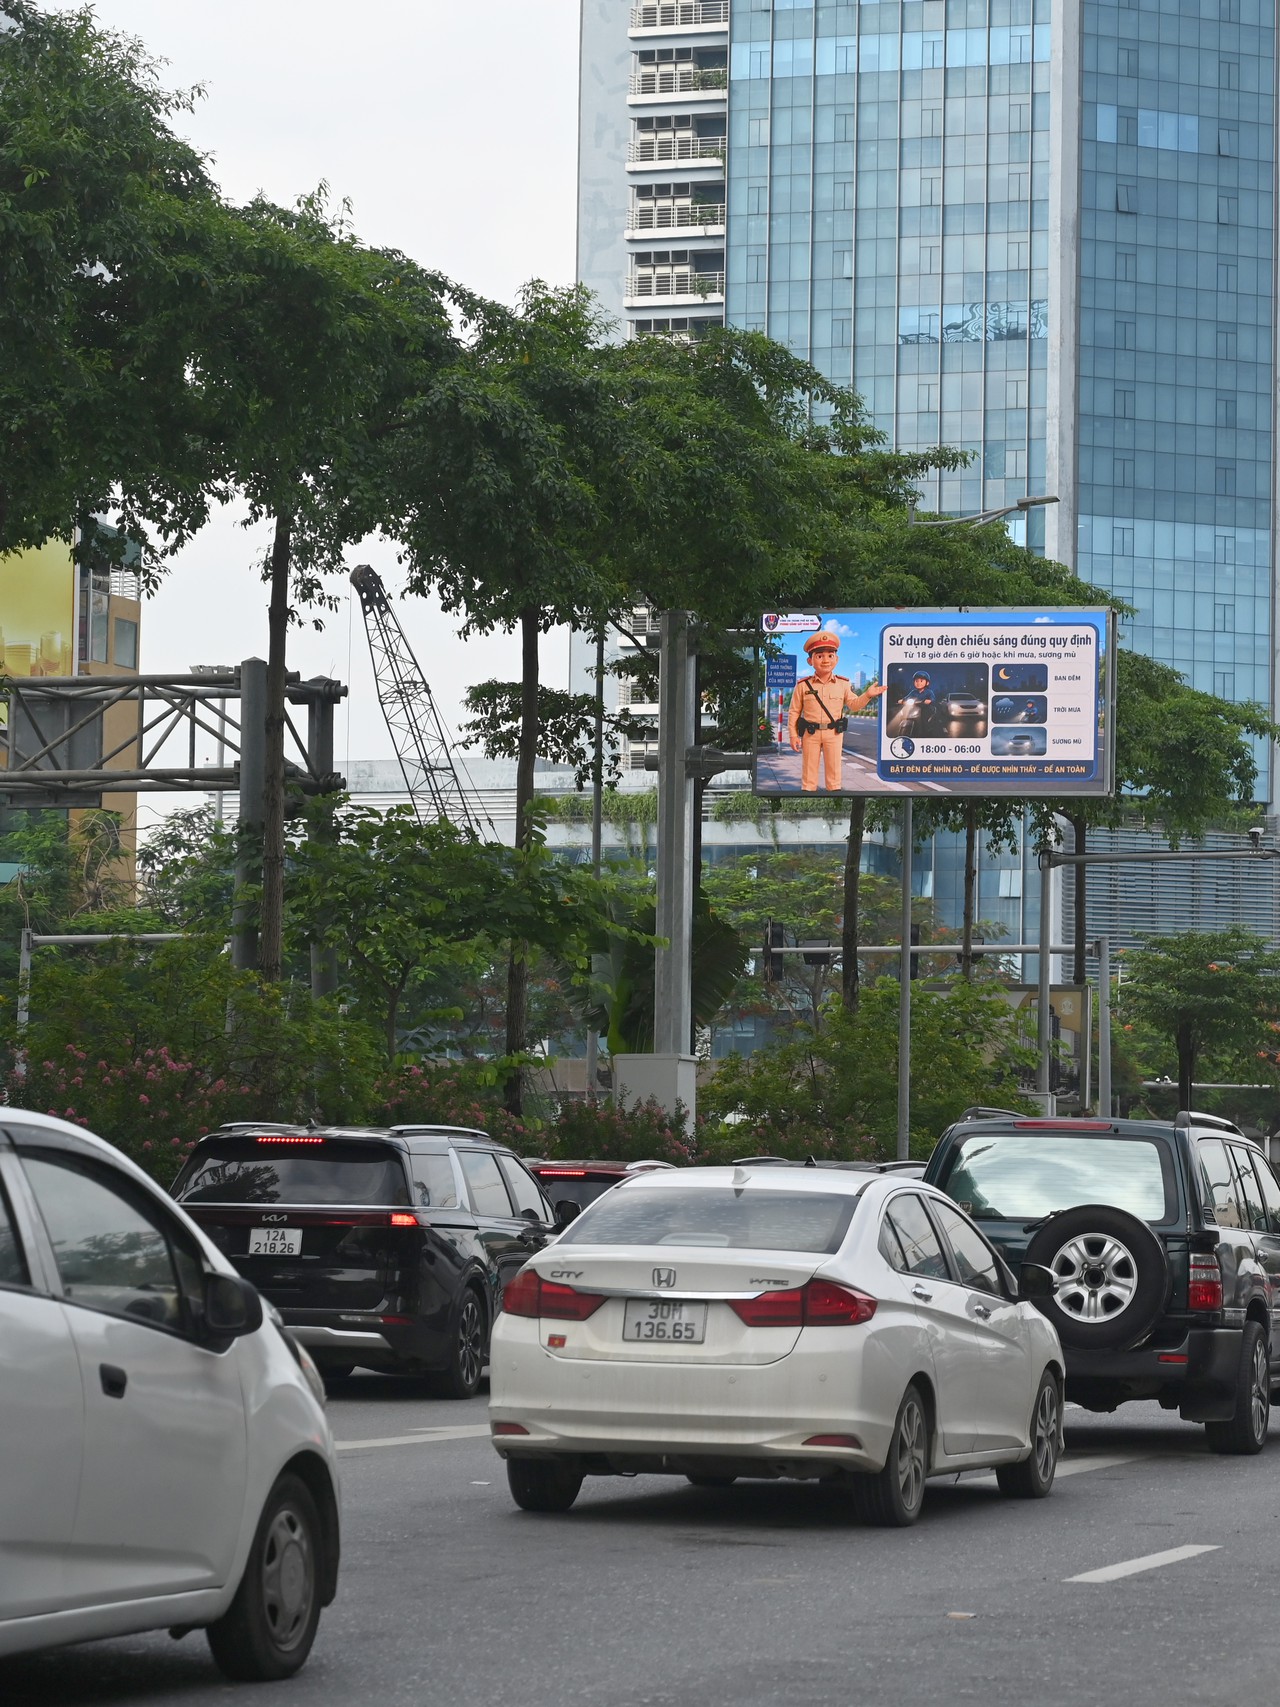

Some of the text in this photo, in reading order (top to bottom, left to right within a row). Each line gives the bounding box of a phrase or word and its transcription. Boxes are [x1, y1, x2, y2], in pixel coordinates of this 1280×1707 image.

[889, 634, 1091, 648] Sử dụng đèn chiếu sáng đúng quy định
[928, 651, 941, 659] giờ
[967, 651, 980, 659] giờ
[982, 651, 1001, 659] hoặc
[921, 745, 946, 753] 18:00
[954, 745, 980, 753] 06:00
[890, 764, 904, 774] BẬT
[906, 765, 920, 773] ĐÈN
[934, 765, 950, 773] NHÌN
[1002, 765, 1018, 773] NHÌN
[1020, 764, 1037, 773] THẤY
[266, 1230, 286, 1241] 12A
[254, 1242, 294, 1253] 218.26
[551, 1270, 584, 1278] CITY
[635, 1321, 695, 1339] 136.65
